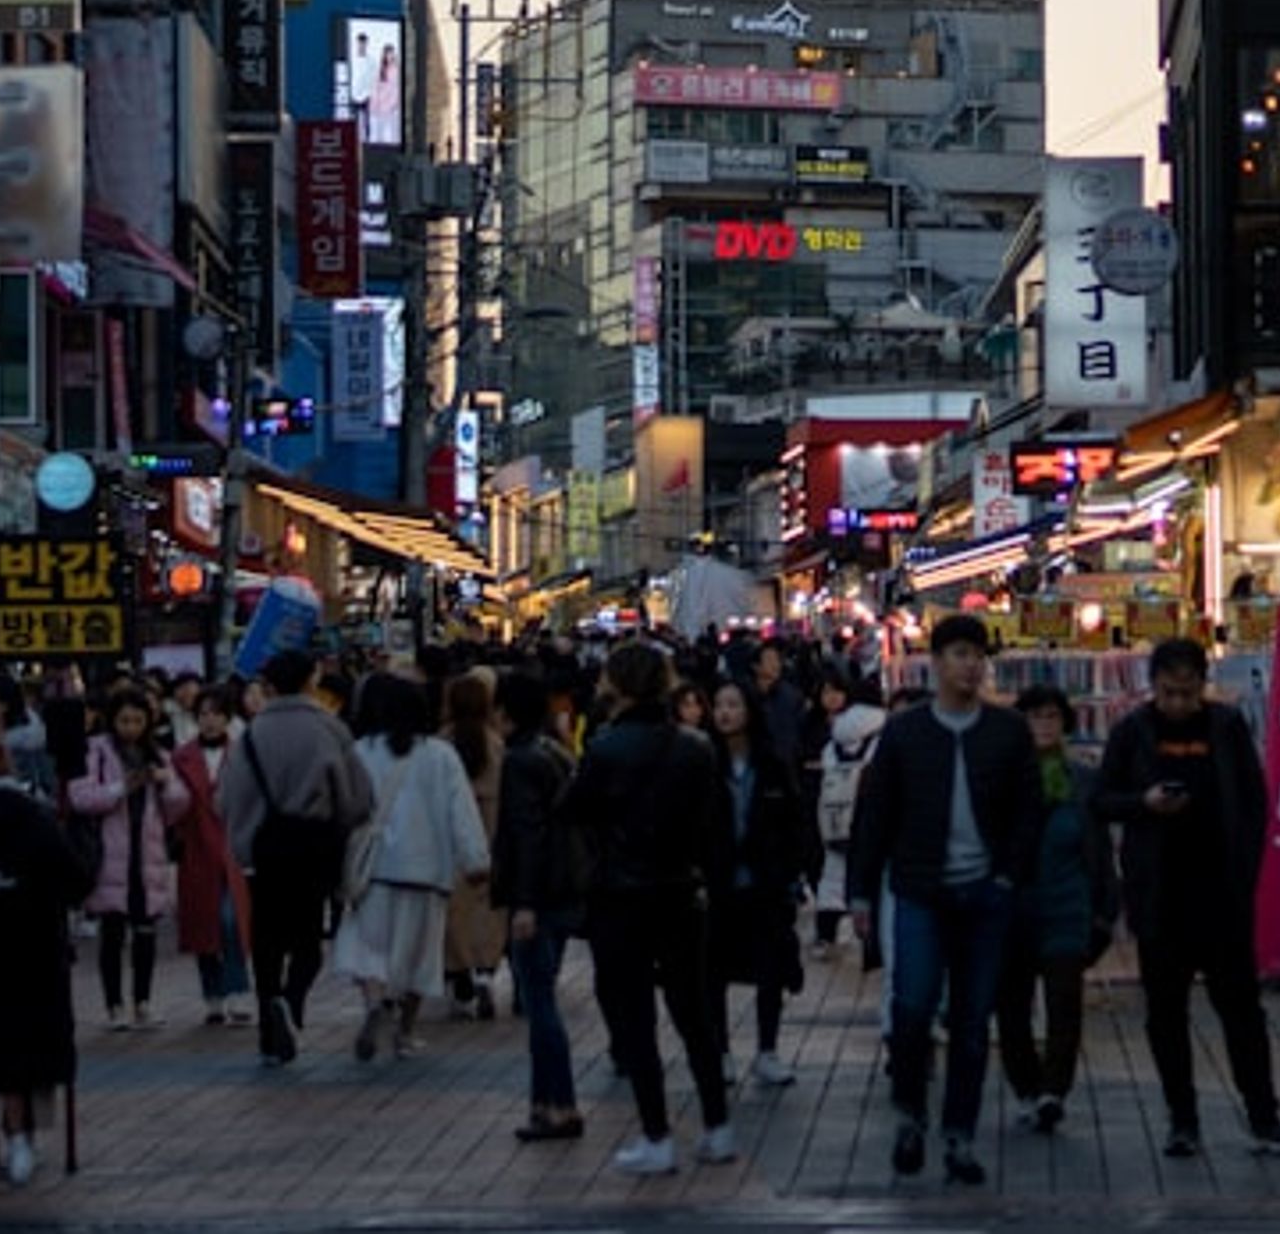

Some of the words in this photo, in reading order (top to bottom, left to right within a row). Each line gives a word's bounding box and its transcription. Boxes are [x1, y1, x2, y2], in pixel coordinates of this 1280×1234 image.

[310, 127, 347, 274] 보드게임
[713, 219, 799, 261] DVD
[3, 609, 112, 647] 방탈출
